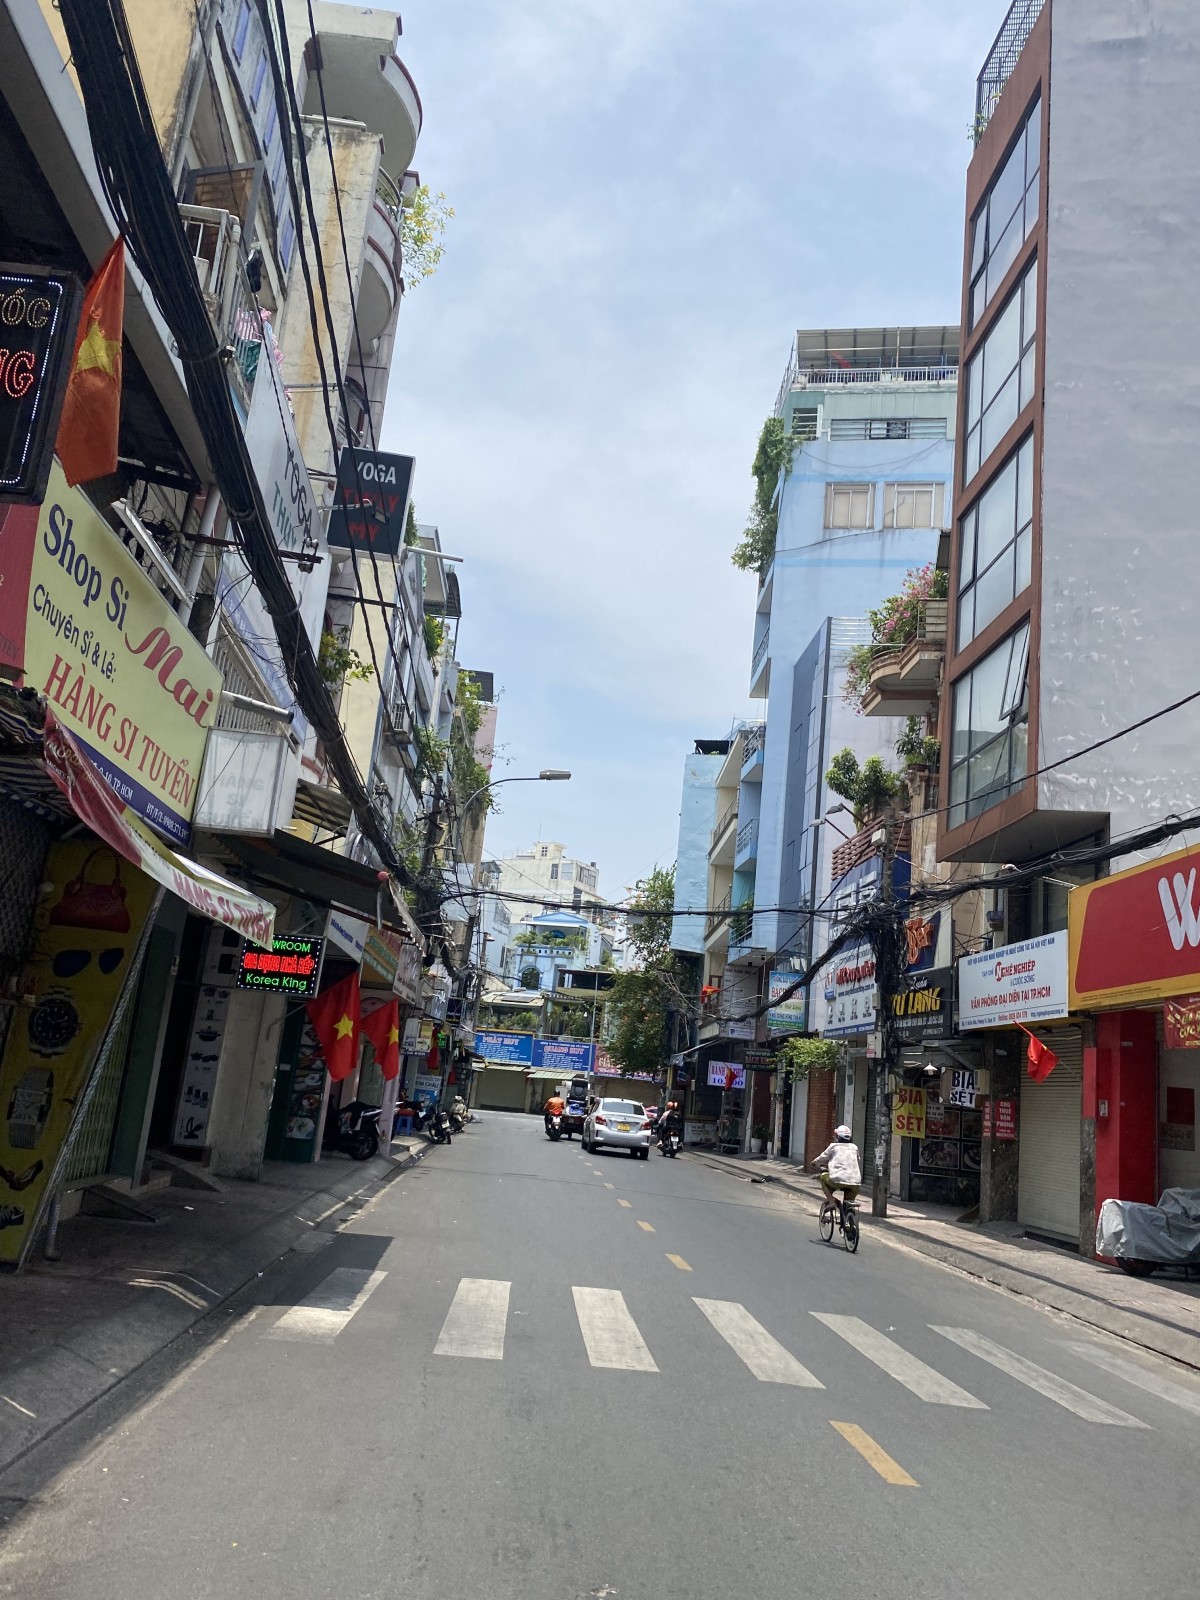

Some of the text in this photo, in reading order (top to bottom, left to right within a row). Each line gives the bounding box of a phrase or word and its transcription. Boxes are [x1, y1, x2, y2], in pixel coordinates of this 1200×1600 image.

[44, 504, 129, 631] Shop Si
[34, 584, 79, 647] Chuyên
[92, 642, 99, 667] &
[125, 627, 213, 728] Mai
[43, 654, 116, 742] HÀNG
[114, 718, 139, 763] SI
[138, 735, 195, 808] TUYỂN
[253, 940, 310, 952] WROOM
[246, 973, 307, 990] Korea King
[999, 995, 1007, 1007] ĐẠI
[1009, 989, 1020, 1005] DIỆN
[1021, 990, 1029, 1004] TẠI
[1030, 986, 1051, 1000] TP.HCM
[951, 1071, 975, 1090] BIA
[898, 1087, 923, 1106] BIA
[950, 1088, 975, 1106] SỆT
[896, 1112, 924, 1134] SỆT
